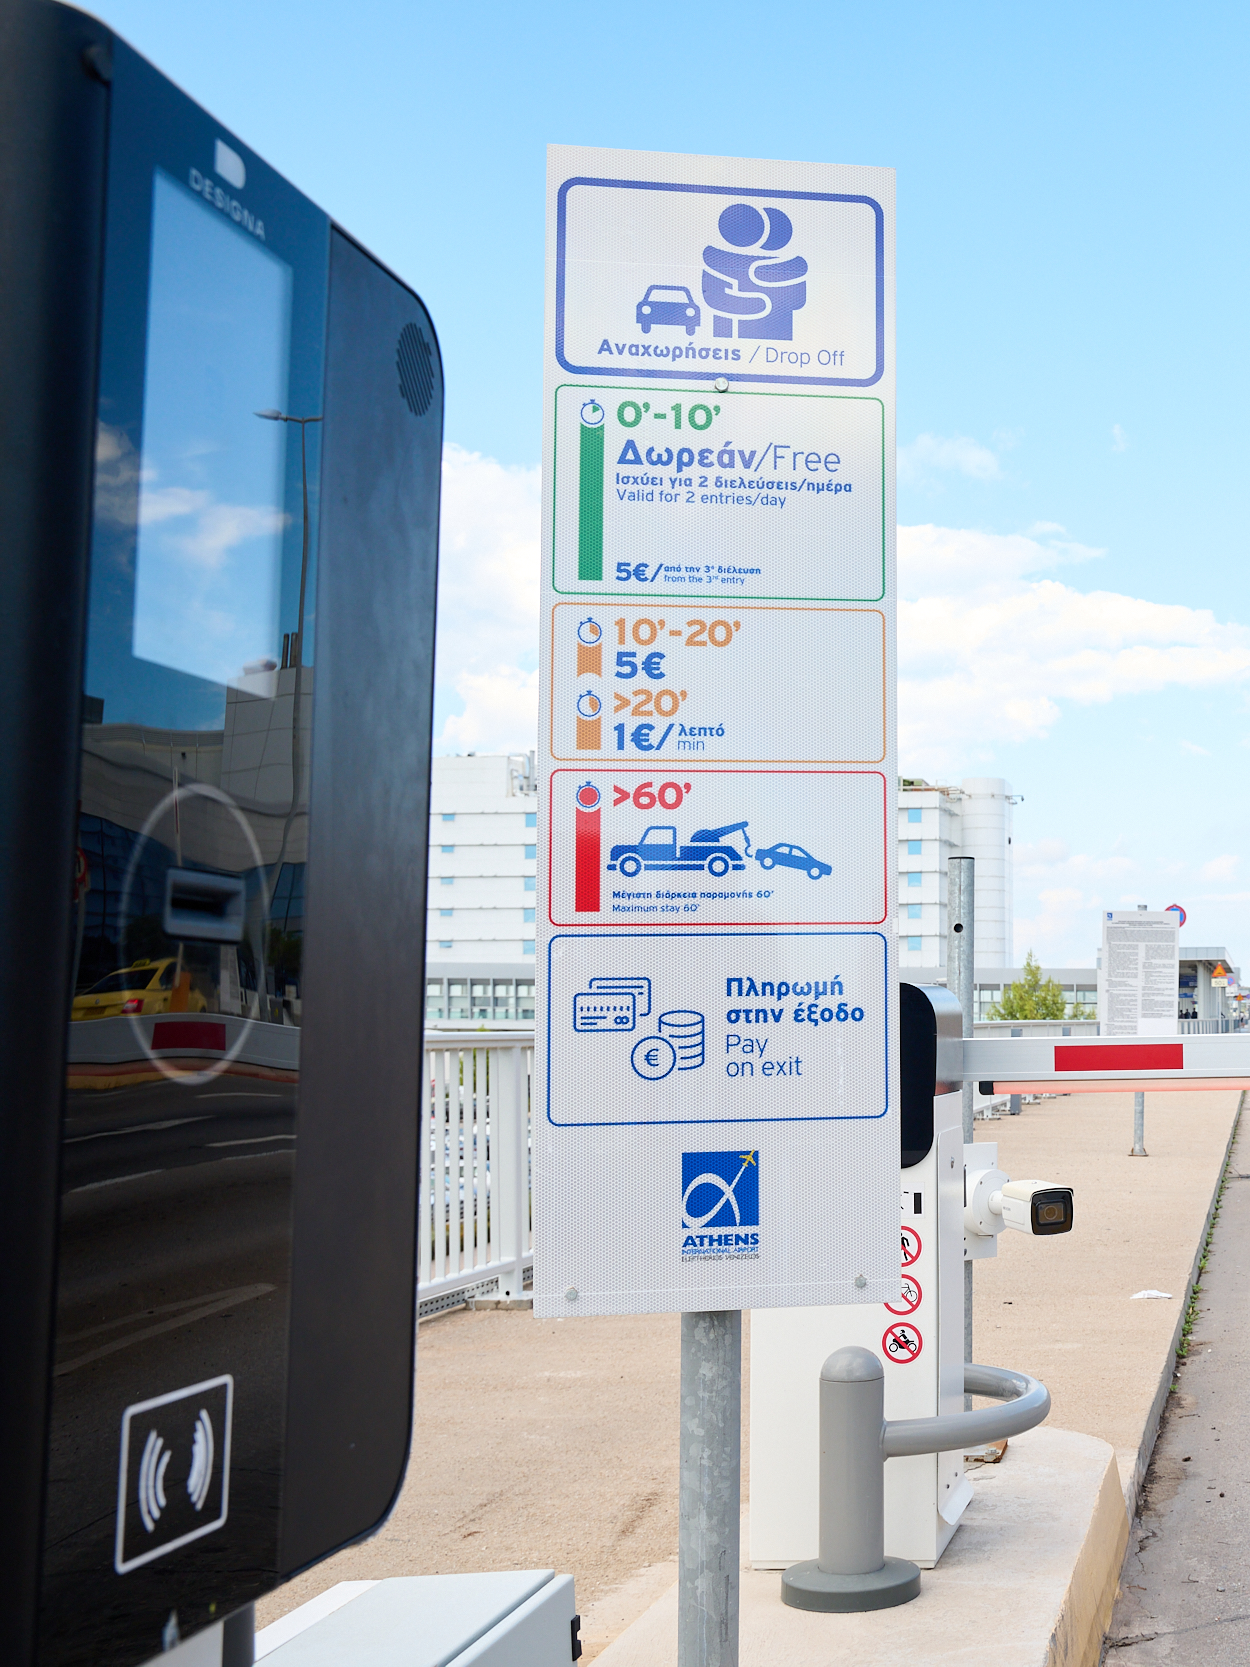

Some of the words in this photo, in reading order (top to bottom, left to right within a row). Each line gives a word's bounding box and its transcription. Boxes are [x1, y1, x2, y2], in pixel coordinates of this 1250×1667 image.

[189, 167, 266, 241] DESIGNA
[597, 338, 742, 362] Αναχωρήσεις
[766, 347, 811, 368] Drop
[818, 349, 845, 366] Off
[616, 472, 663, 487] Ισχύει
[669, 477, 693, 489] για
[699, 475, 709, 488] 2
[616, 488, 654, 502] Valid
[659, 490, 681, 502] for
[686, 491, 696, 503] 2
[701, 492, 787, 509] entries/day
[664, 564, 682, 573] από
[717, 565, 761, 575] διέλευση
[664, 574, 686, 583] from
[689, 574, 703, 583] the
[721, 576, 745, 585] entry
[614, 651, 667, 680] 5€
[678, 723, 725, 739] λεπτό
[678, 739, 705, 751] min
[612, 890, 652, 900] Μέγιστη
[655, 890, 697, 900] διάρκεια
[612, 904, 658, 912] Maximum
[660, 904, 681, 913] stay
[726, 974, 844, 1001] Πληρωμή
[726, 1008, 784, 1024] στην
[793, 1002, 864, 1027] έξοδο
[726, 1034, 768, 1058] Pay
[726, 1061, 754, 1077] on
[762, 1056, 802, 1077] exit
[682, 1233, 760, 1248] ATHENS
